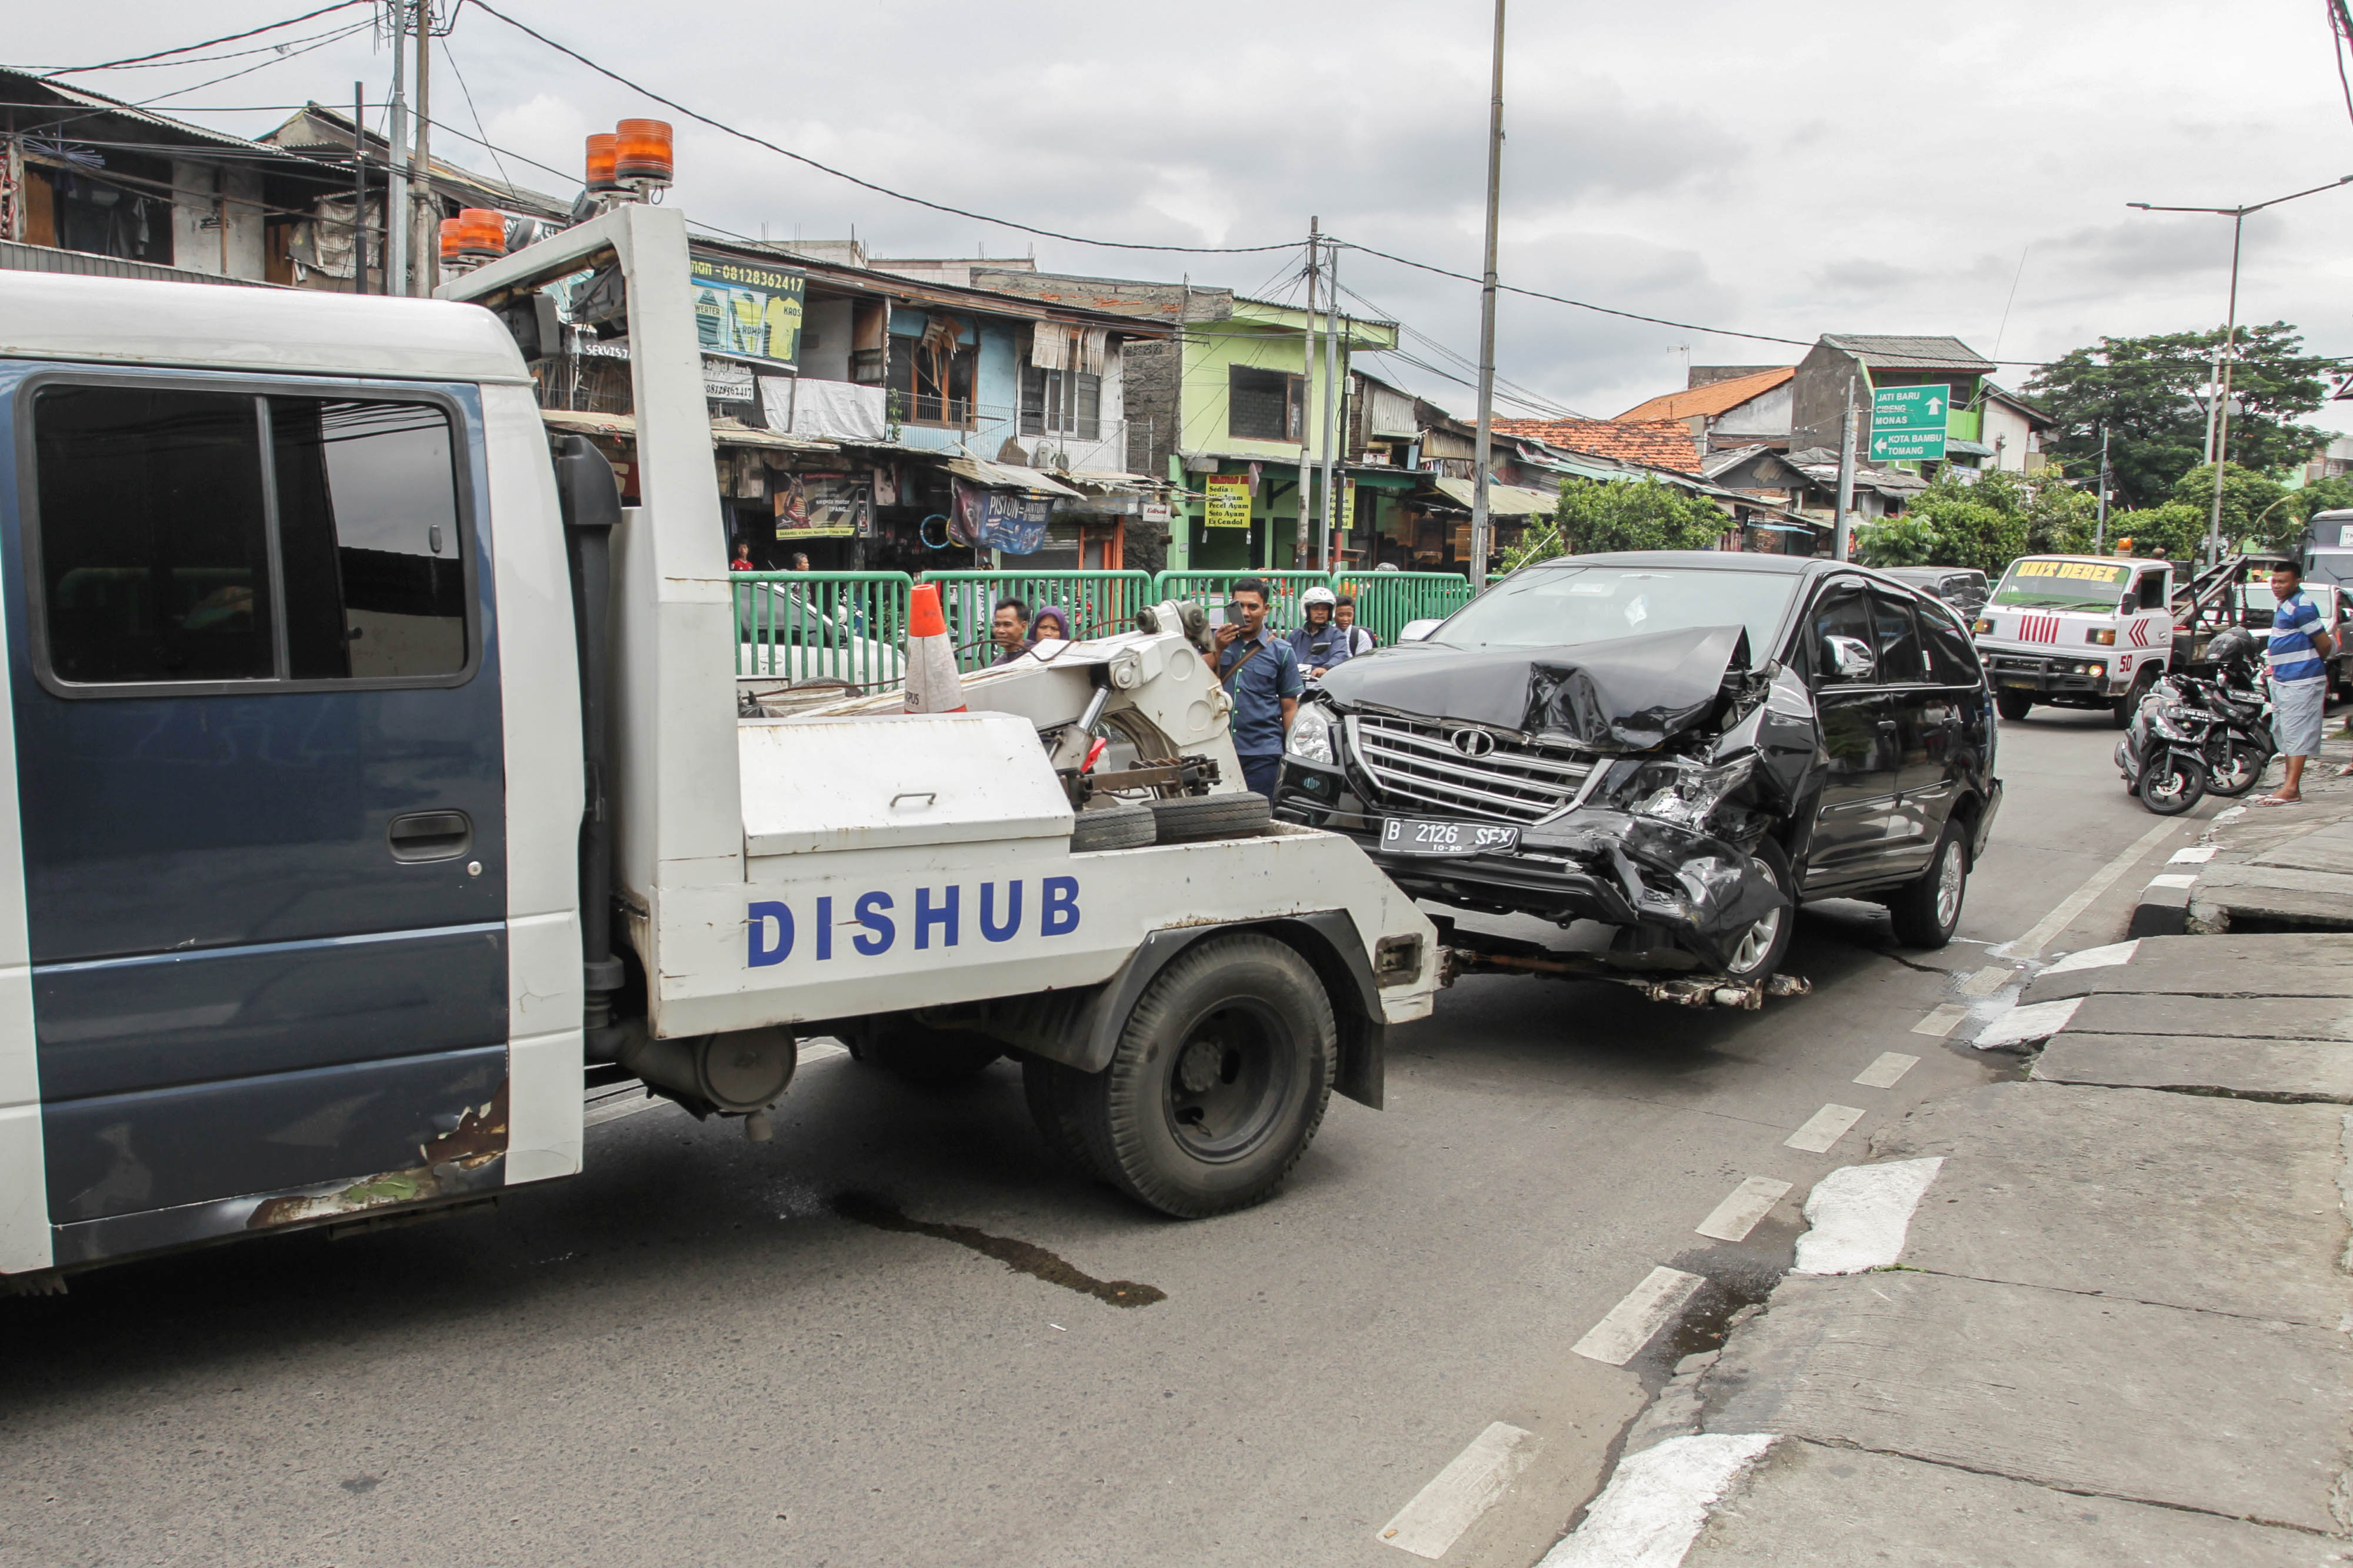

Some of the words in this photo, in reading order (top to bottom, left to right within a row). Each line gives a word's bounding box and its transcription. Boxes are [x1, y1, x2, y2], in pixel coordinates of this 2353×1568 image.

[722, 265, 804, 292] 08128362417
[784, 306, 801, 317] KAOS
[742, 325, 764, 338] ROMPI
[1877, 393, 1894, 402] JATI
[1896, 392, 1920, 401] BARU
[1875, 416, 1908, 425] MONAS
[1888, 435, 1909, 443] KOTA
[1911, 434, 1942, 443] BAMBU
[1888, 446, 1924, 455] TOMANG
[989, 496, 1020, 519] PISTON
[2016, 561, 2061, 577] UNIT
[2056, 562, 2121, 583] DEREK
[2119, 654, 2133, 673] 50
[1387, 821, 1401, 840] B
[1415, 823, 1459, 843] 2126
[1475, 828, 1512, 845] SFX
[747, 875, 1081, 968] DISHUB
